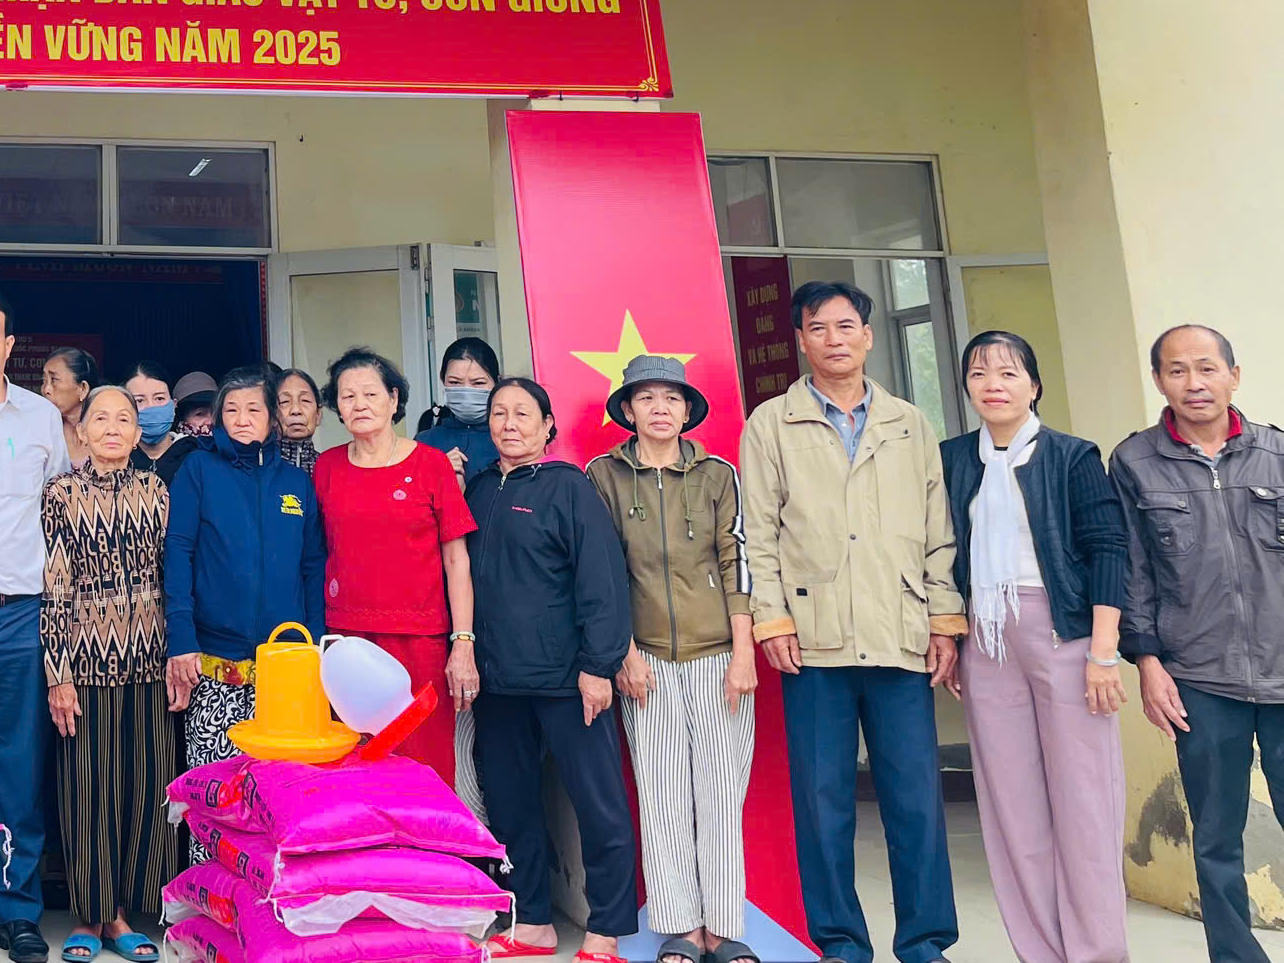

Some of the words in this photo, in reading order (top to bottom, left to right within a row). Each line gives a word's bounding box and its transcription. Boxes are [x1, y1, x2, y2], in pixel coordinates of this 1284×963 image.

[45, 18, 143, 62] VỮNG
[155, 20, 241, 63] NĂM
[253, 29, 341, 66] 2025
